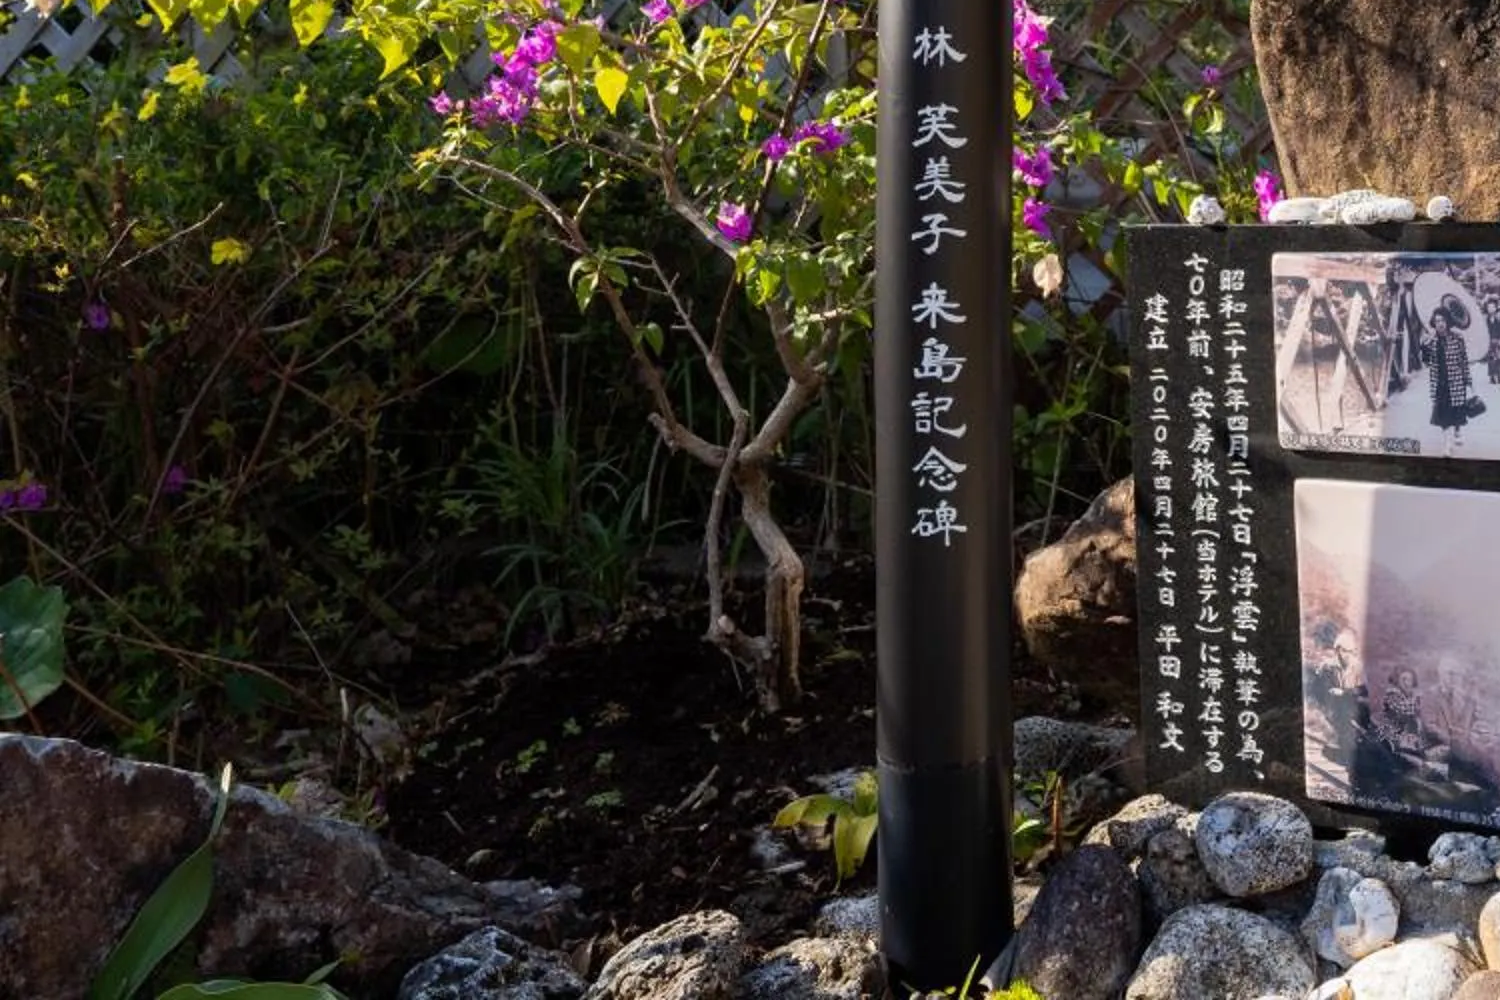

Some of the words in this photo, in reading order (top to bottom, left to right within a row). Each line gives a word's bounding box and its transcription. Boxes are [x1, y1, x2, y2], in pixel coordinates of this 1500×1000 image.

[911, 25, 968, 68] 林
[911, 104, 968, 256] 芙美子
[1143, 291, 1170, 351] 建立
[911, 281, 968, 548] 来島記念碑
